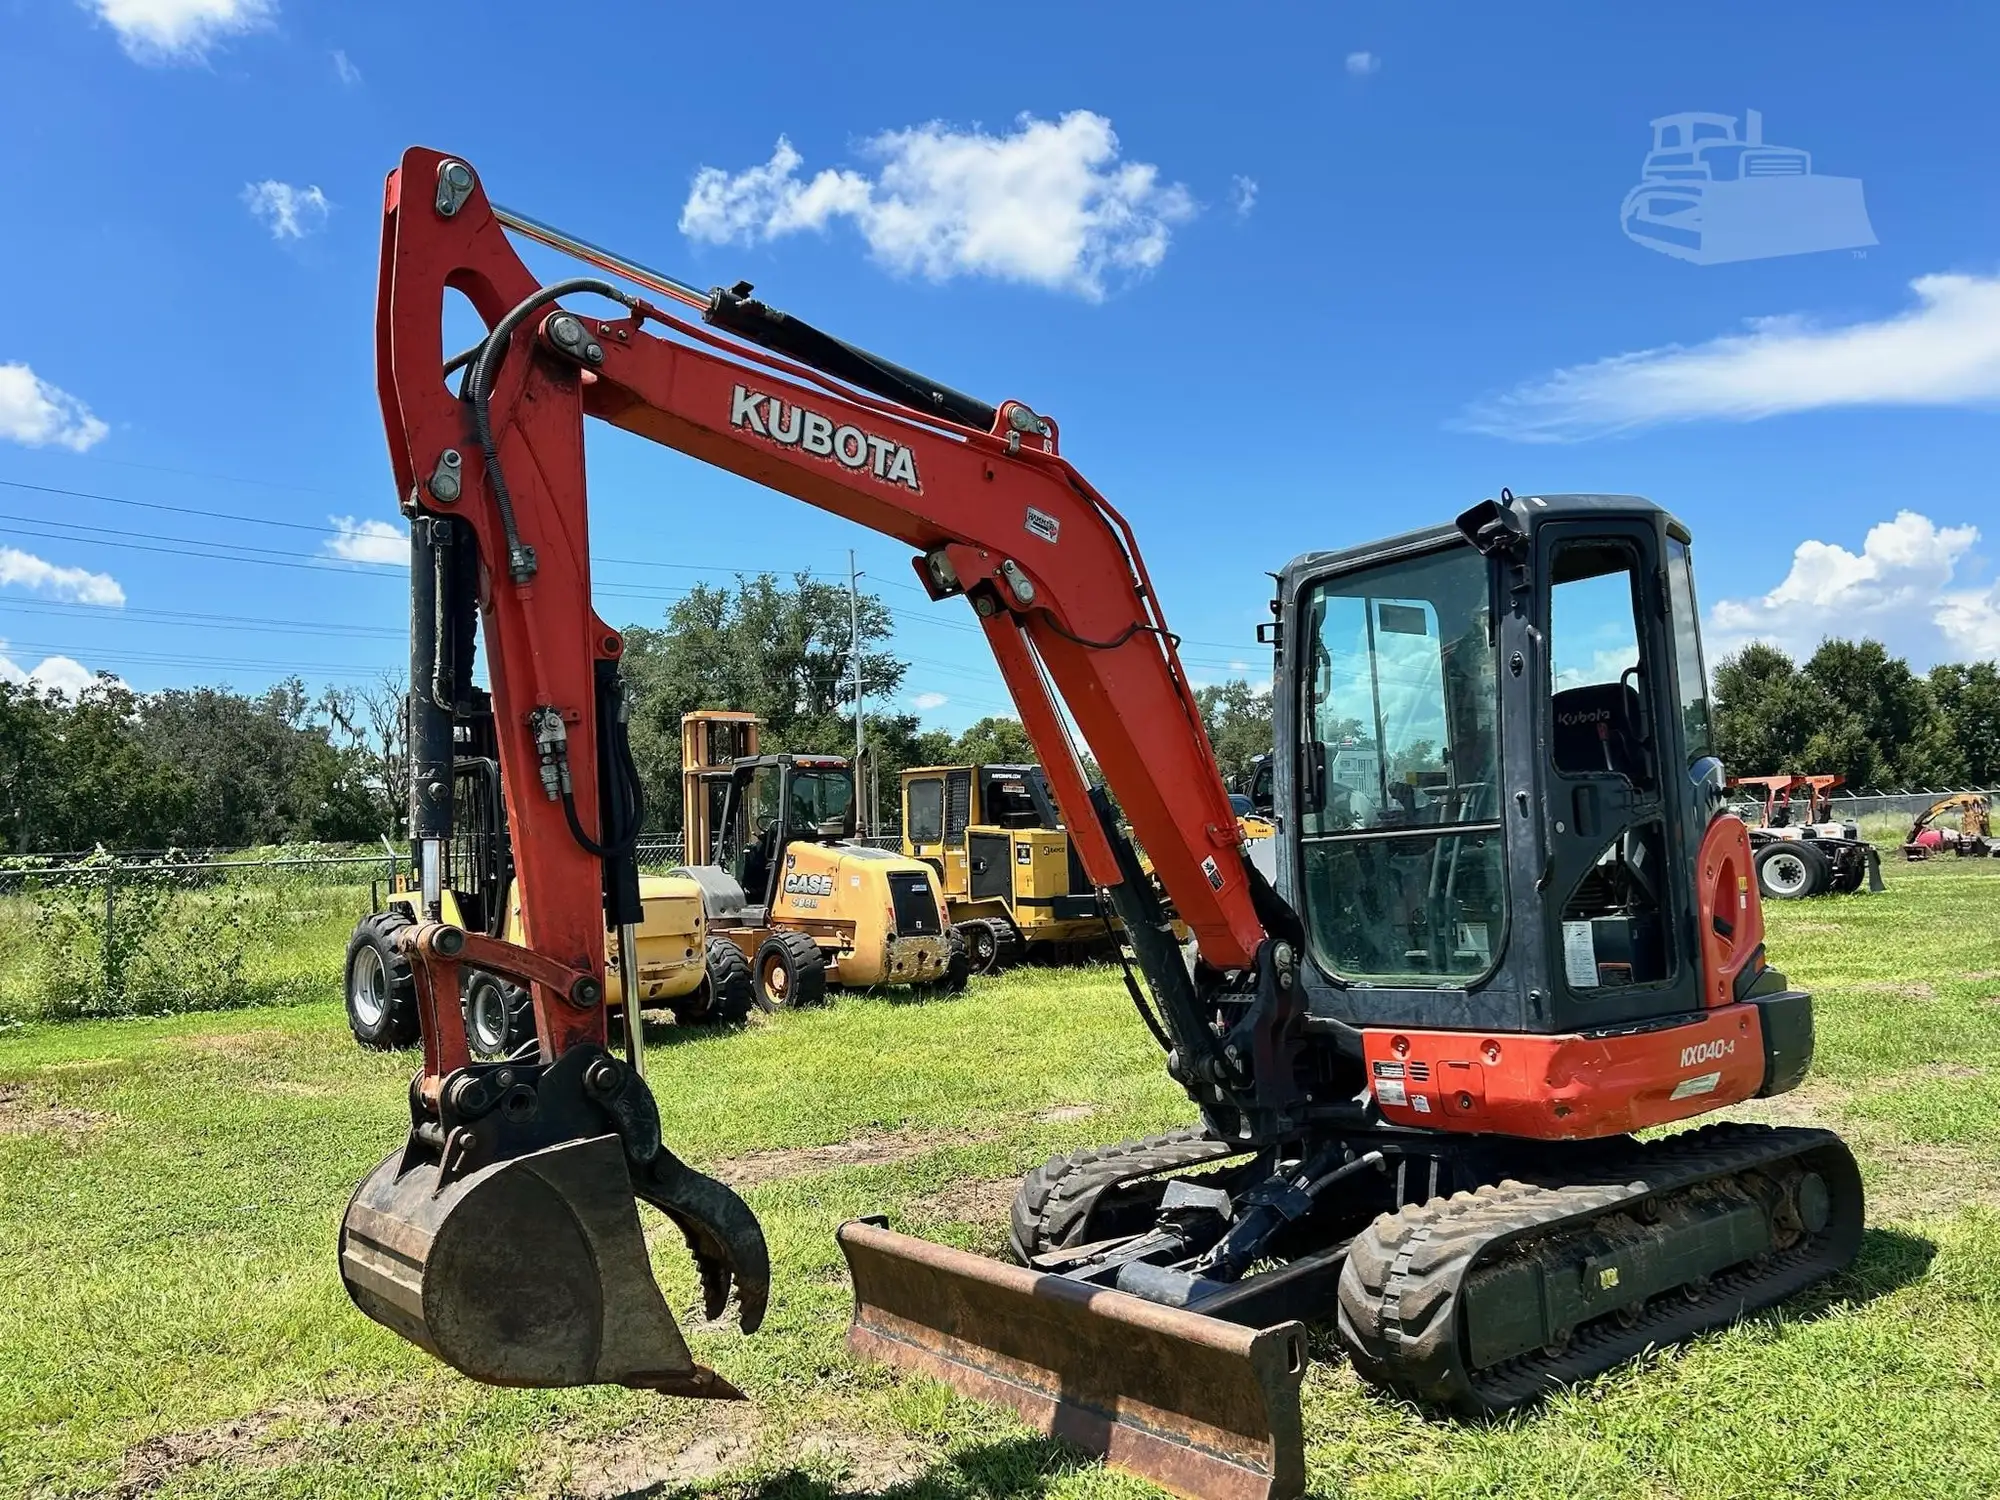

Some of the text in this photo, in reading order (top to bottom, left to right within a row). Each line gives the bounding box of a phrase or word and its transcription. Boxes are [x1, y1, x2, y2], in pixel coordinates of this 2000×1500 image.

[730, 384, 921, 490] KUBOTA
[1558, 708, 1610, 726] Kubota
[785, 873, 832, 896] CASE
[1680, 1039, 1735, 1068] KX040-4
